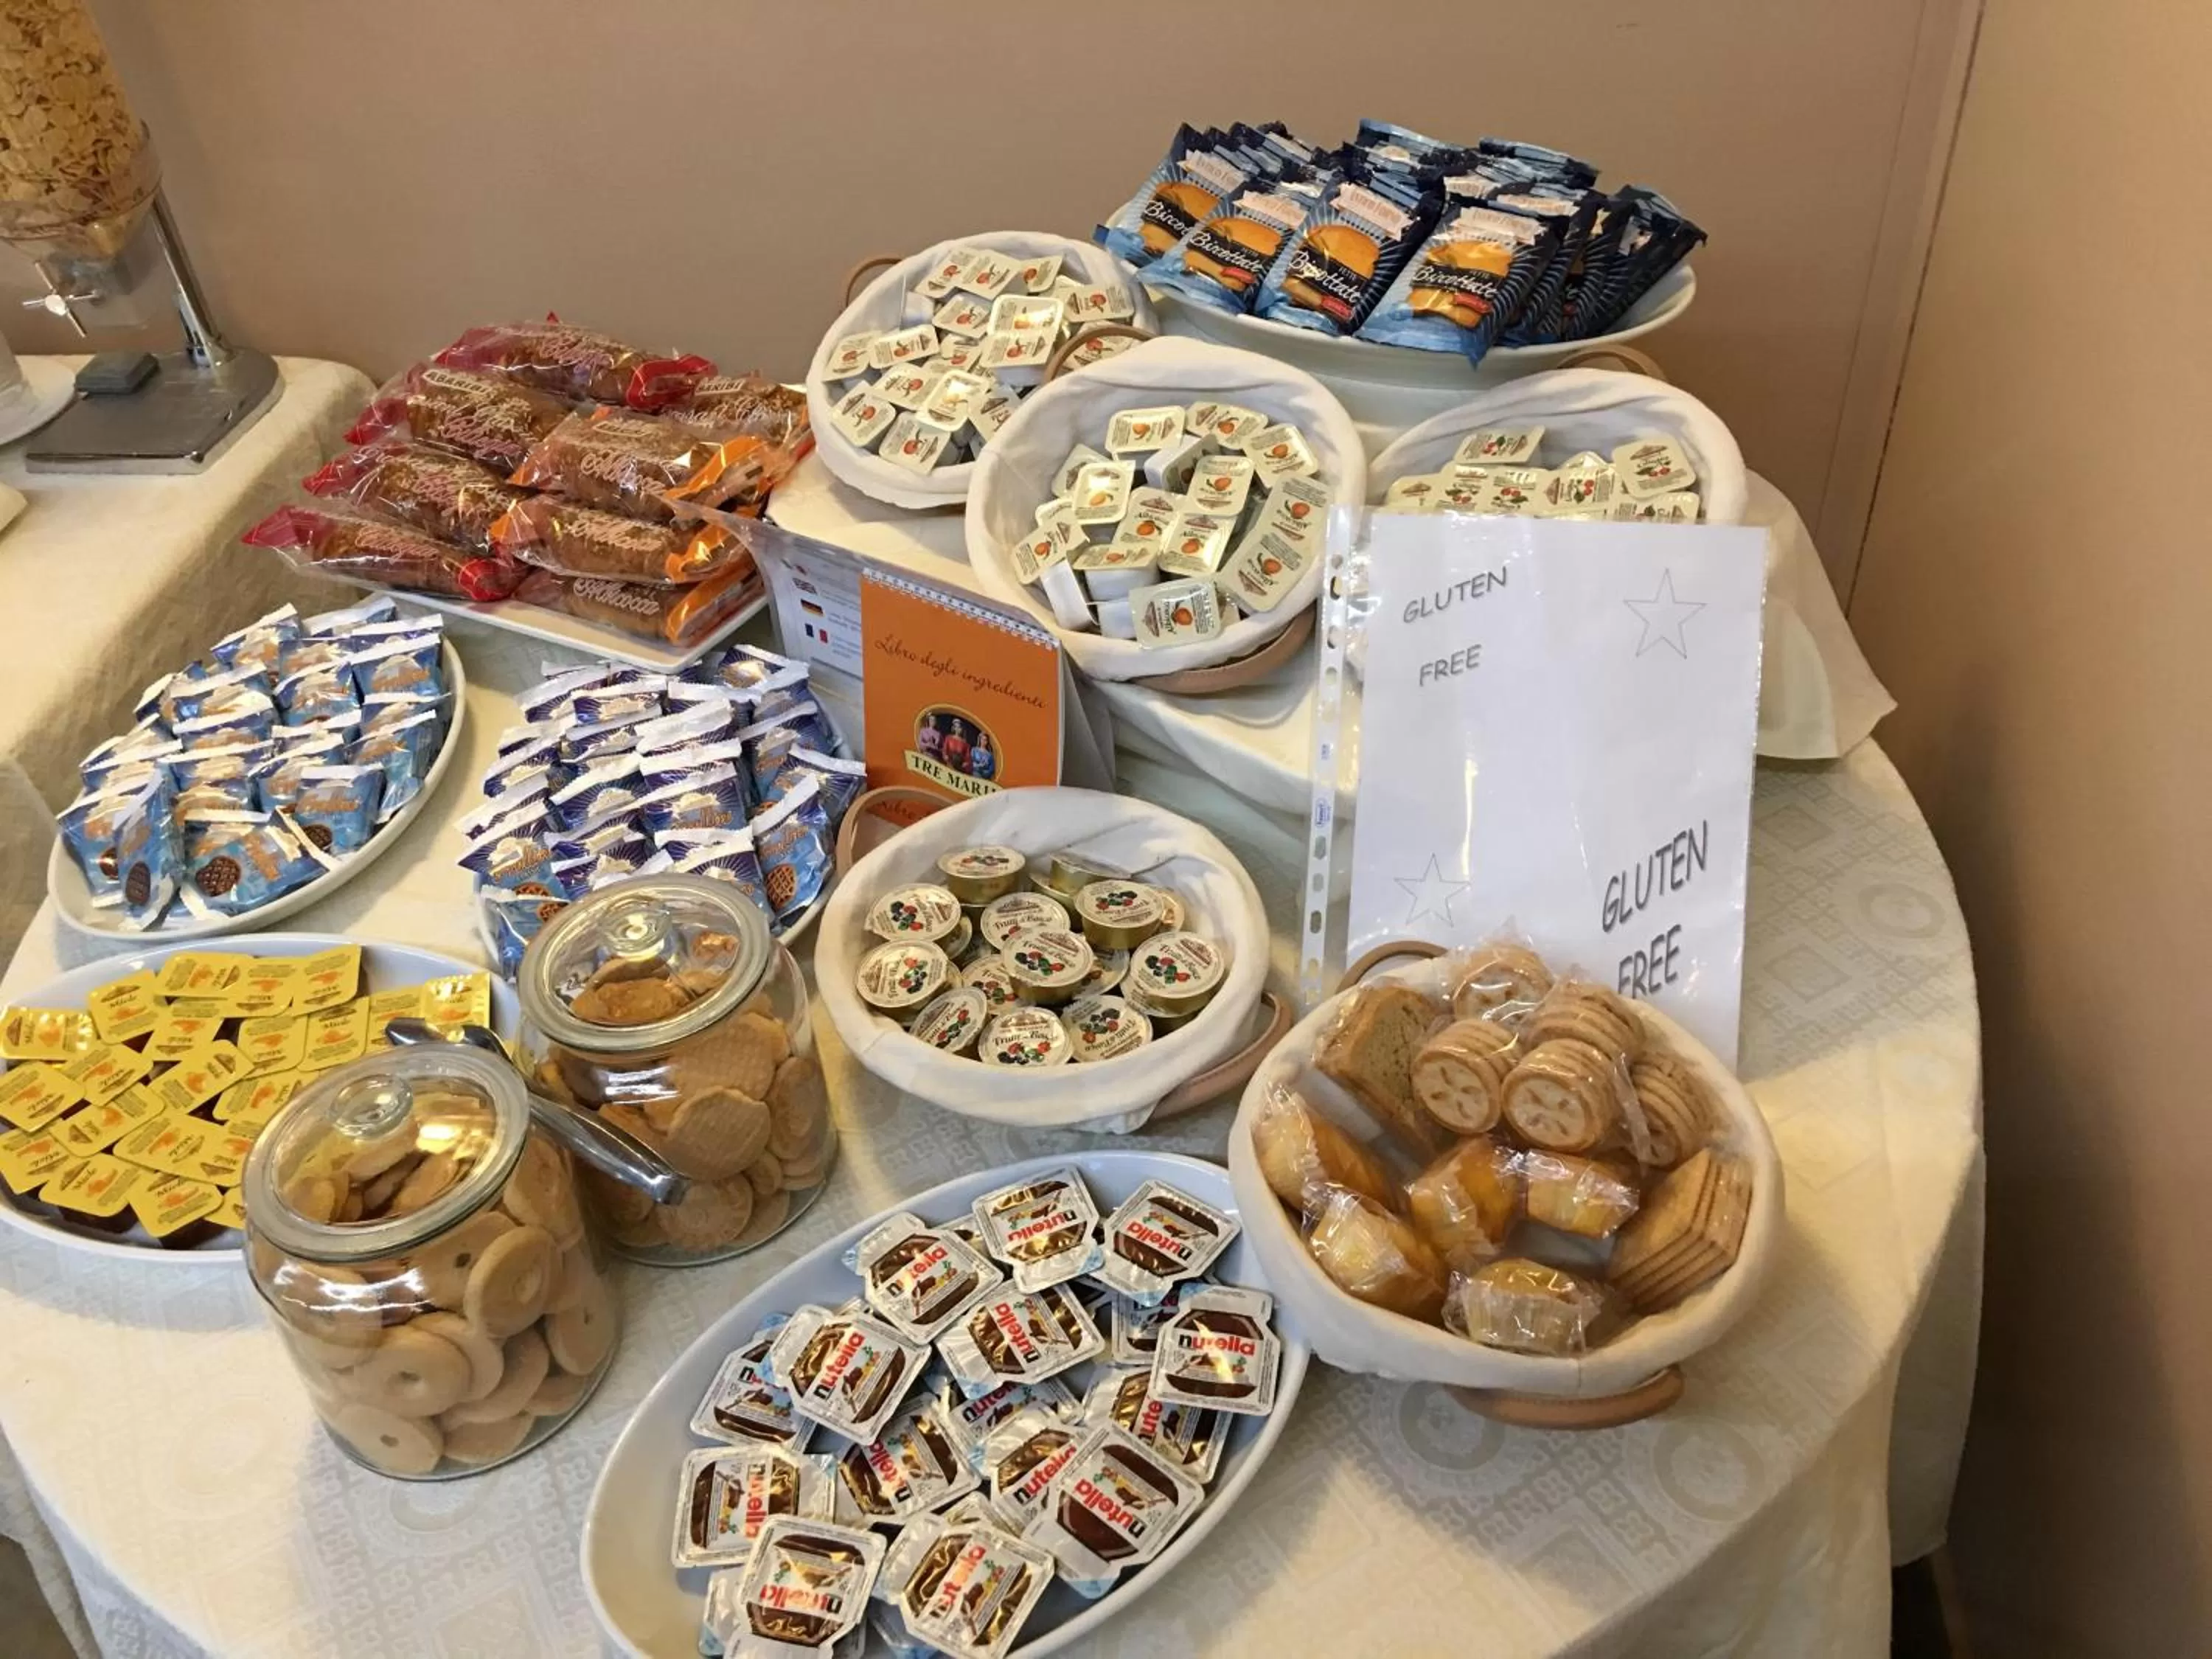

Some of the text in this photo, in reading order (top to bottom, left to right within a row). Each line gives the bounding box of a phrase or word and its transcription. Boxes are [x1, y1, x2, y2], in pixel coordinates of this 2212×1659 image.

[1403, 566, 1508, 624] GLUTEN
[874, 635, 1046, 709] Libro degli ingredienti
[1419, 644, 1482, 686] FREE
[911, 754, 996, 796] TRE MARI
[1602, 820, 1708, 933] GLUTEN
[1618, 925, 1680, 999] FREE
[1009, 1209, 1077, 1242] nutella
[1126, 1220, 1192, 1261] nutella
[995, 1302, 1040, 1363] nutella
[813, 1331, 865, 1400] nutella
[1139, 1400, 1163, 1444] nute
[1074, 1478, 1147, 1539] nutella
